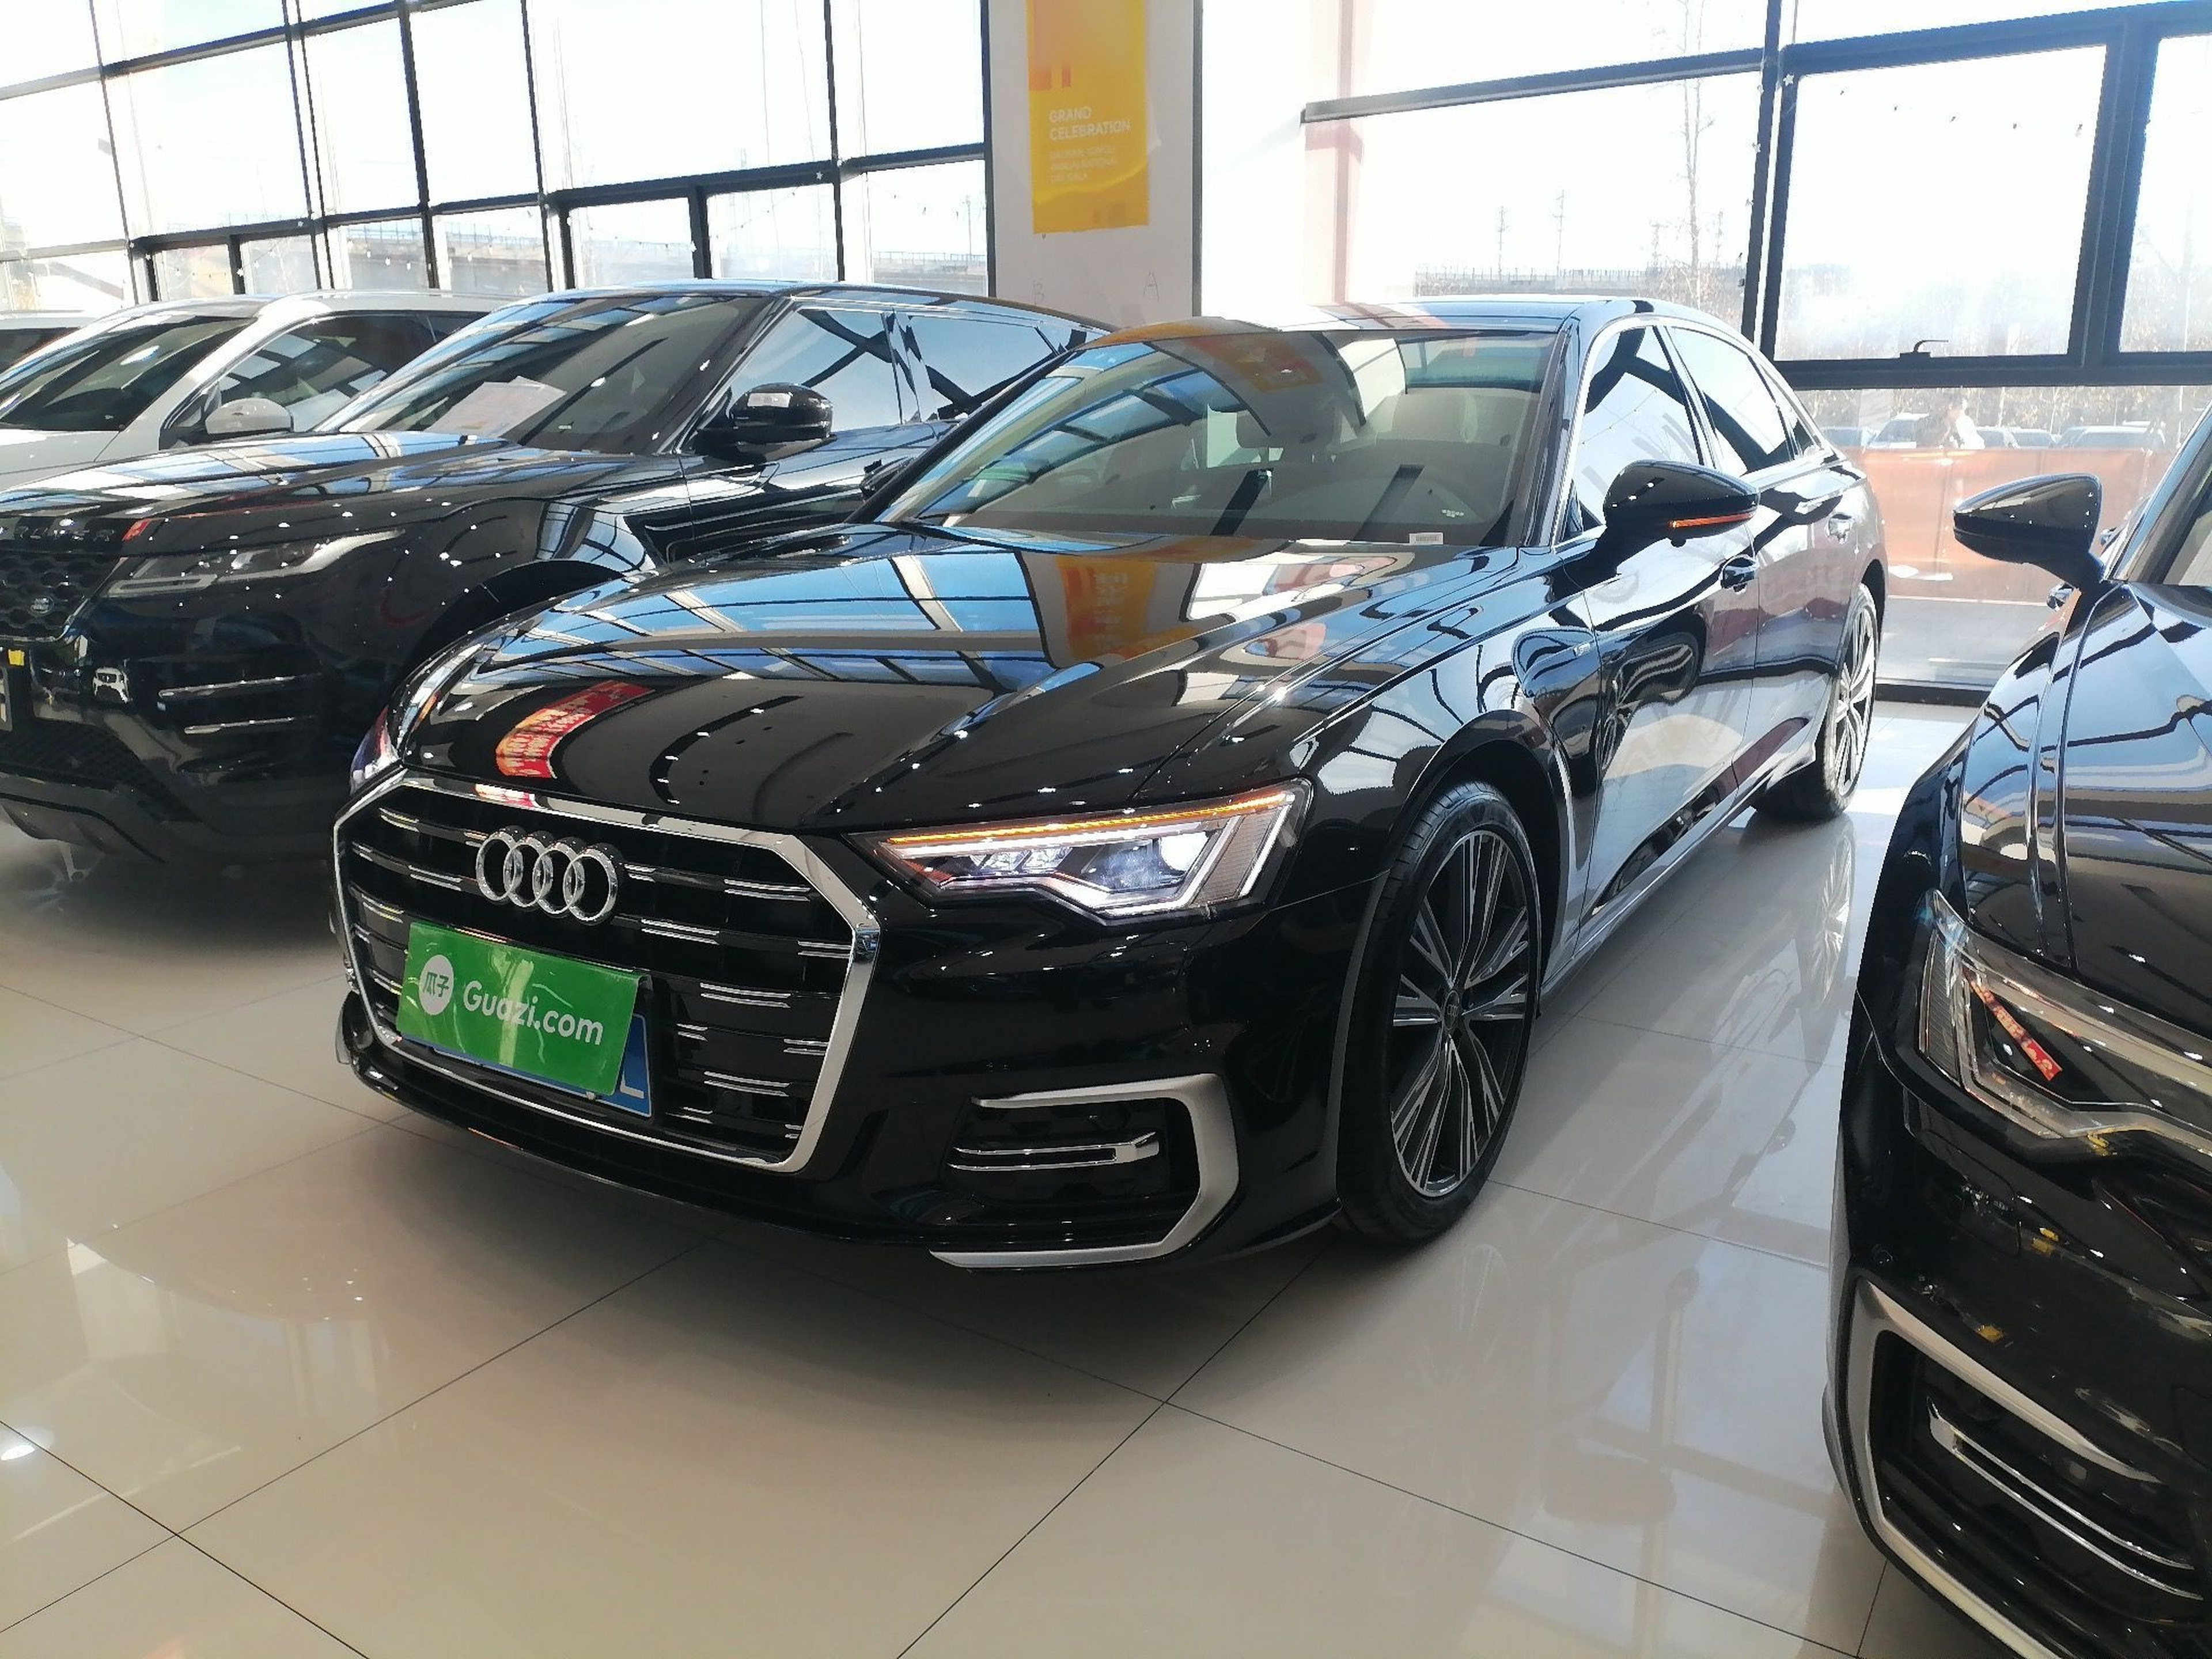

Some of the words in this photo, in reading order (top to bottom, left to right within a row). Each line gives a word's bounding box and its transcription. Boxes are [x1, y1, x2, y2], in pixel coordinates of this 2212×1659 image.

[1049, 106, 1092, 123] GRAND
[1050, 119, 1131, 140] CELEBRATION
[422, 971, 449, 998] 瓜子
[463, 980, 603, 1045] Guazi.com
